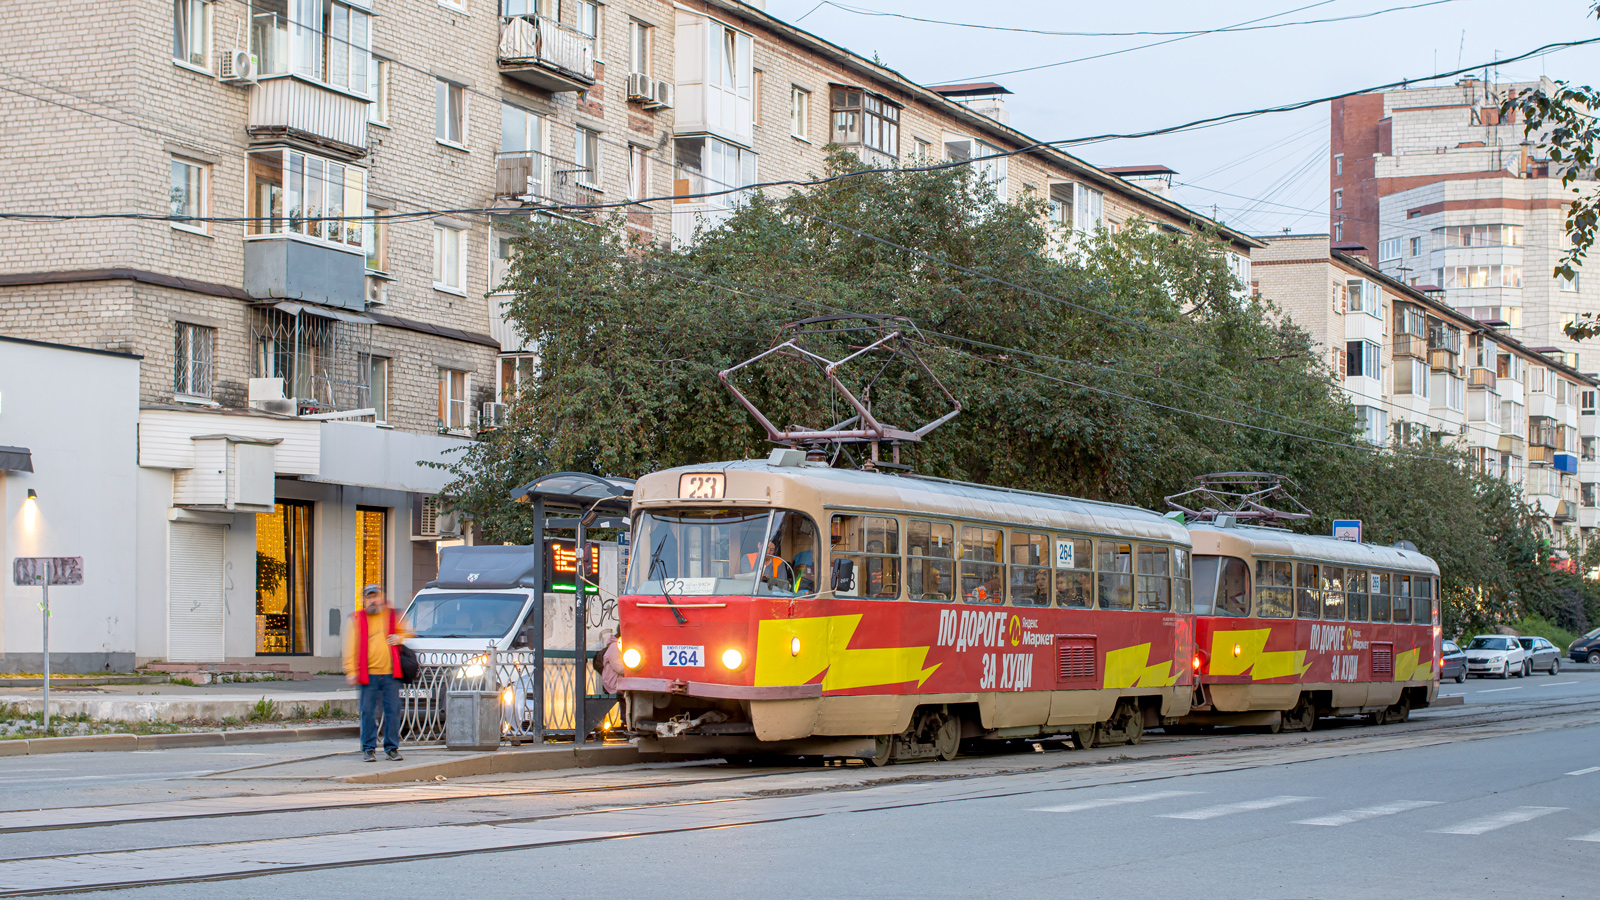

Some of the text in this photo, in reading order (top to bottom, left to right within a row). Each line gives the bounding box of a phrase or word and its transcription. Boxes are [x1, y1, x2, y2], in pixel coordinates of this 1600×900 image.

[689, 476, 717, 498] 23
[1059, 543, 1072, 560] 264
[937, 609, 1008, 652] ПО ДОРОГЕ
[1022, 617, 1038, 629] Яндекс
[1022, 631, 1054, 647] Маркет
[1310, 624, 1346, 654] ПО ДОРОГЕ
[668, 650, 698, 665] 264
[1331, 655, 1358, 682] ЗА ХУДИ
[980, 653, 1033, 691] ЗА ХУДИ
